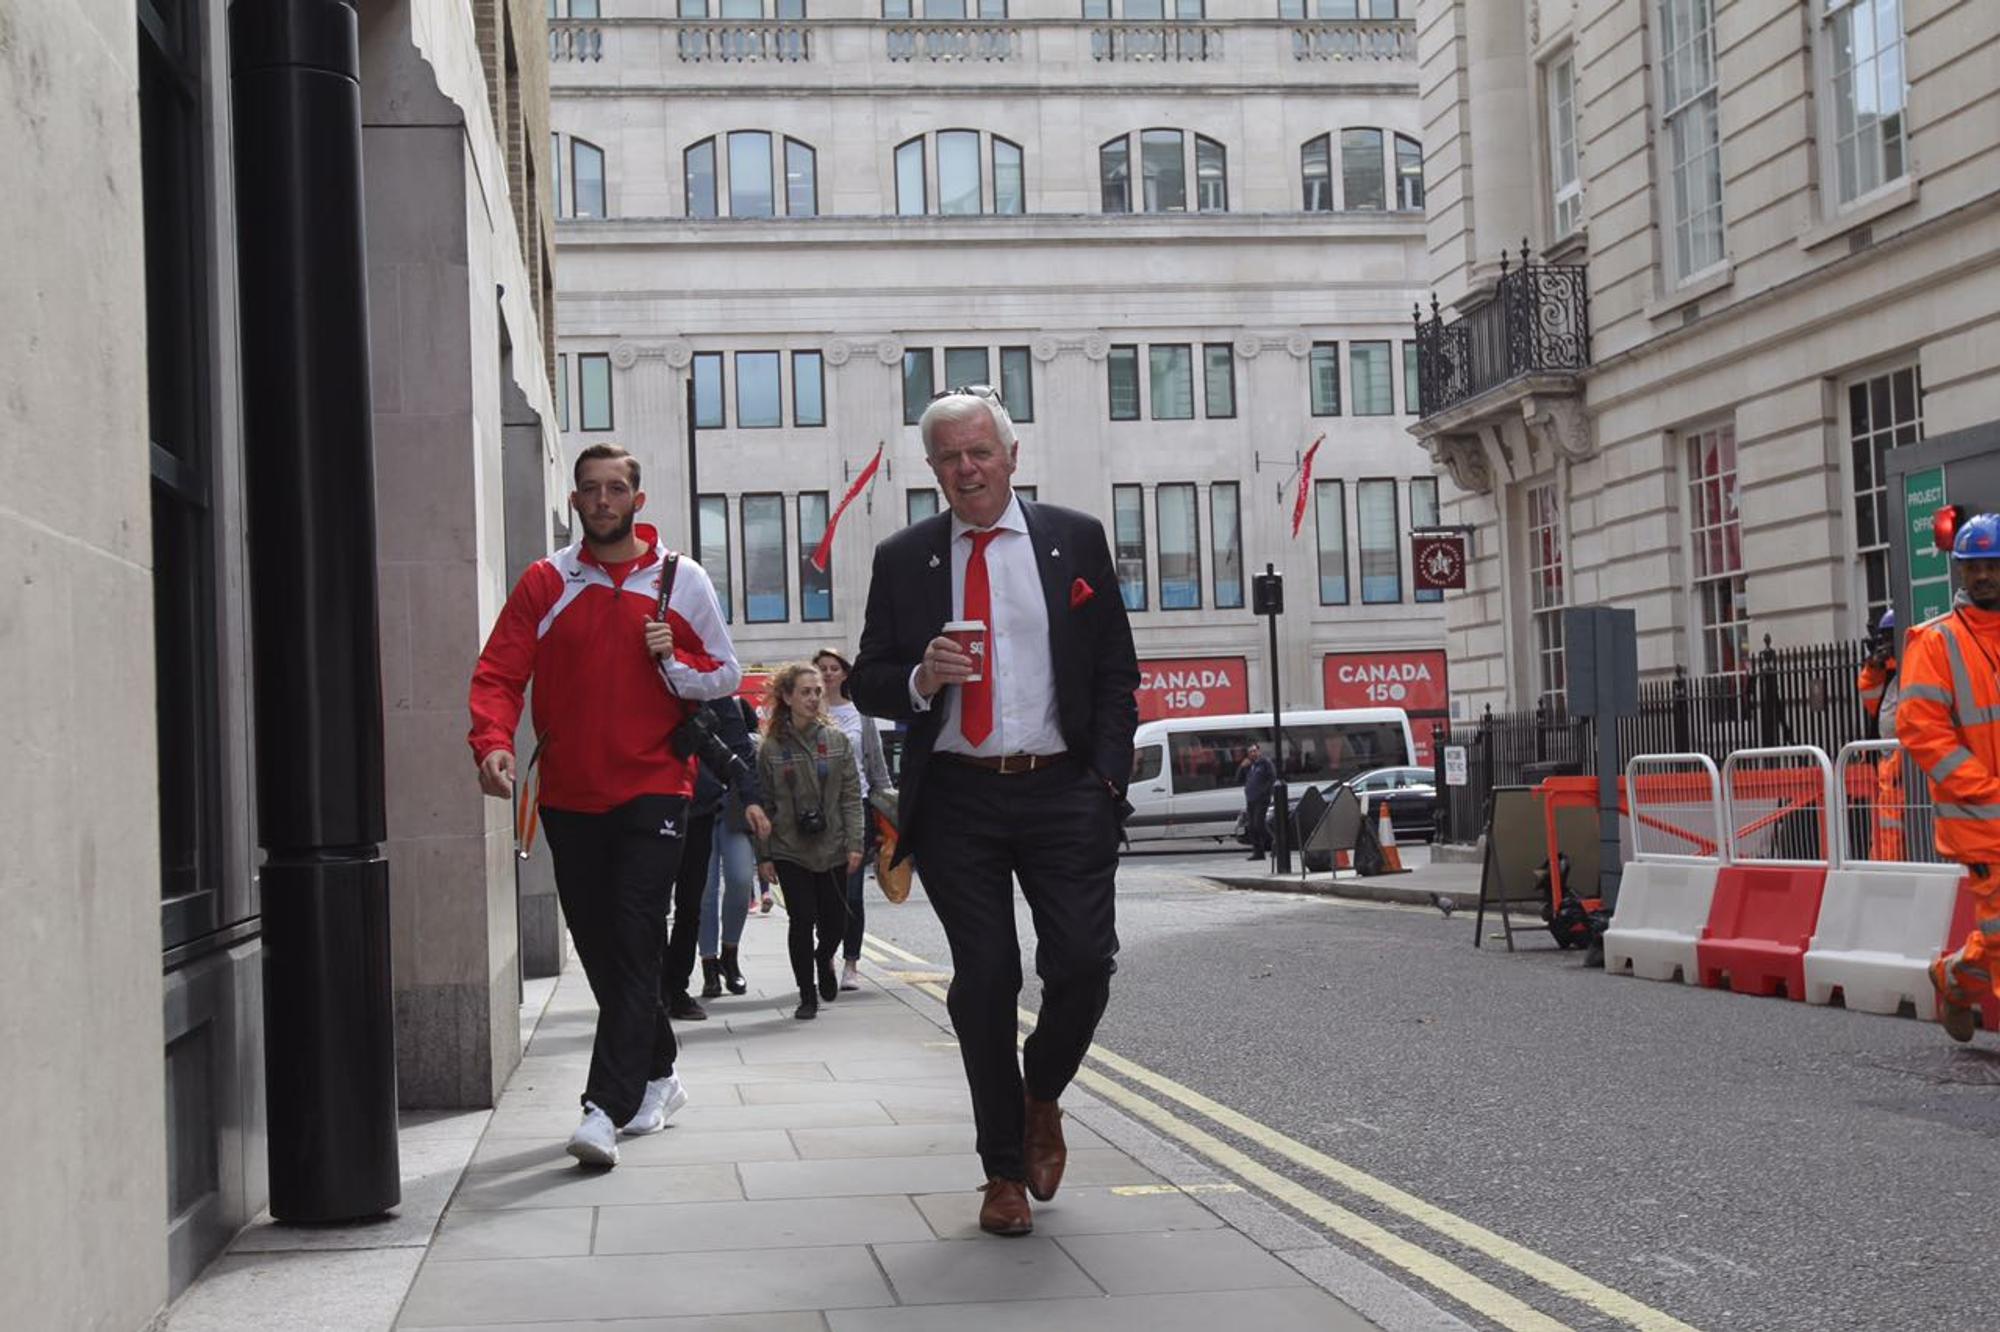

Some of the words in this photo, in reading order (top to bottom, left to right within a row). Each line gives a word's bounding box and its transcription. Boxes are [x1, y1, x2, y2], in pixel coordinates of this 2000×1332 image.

[1908, 487, 1941, 506] PROJECT
[1912, 515, 1936, 533] OFFIC
[1139, 669, 1231, 690] CANADA
[1338, 663, 1431, 683] CANADA
[1164, 690, 1206, 709] 150
[1365, 683, 1407, 702] 150
